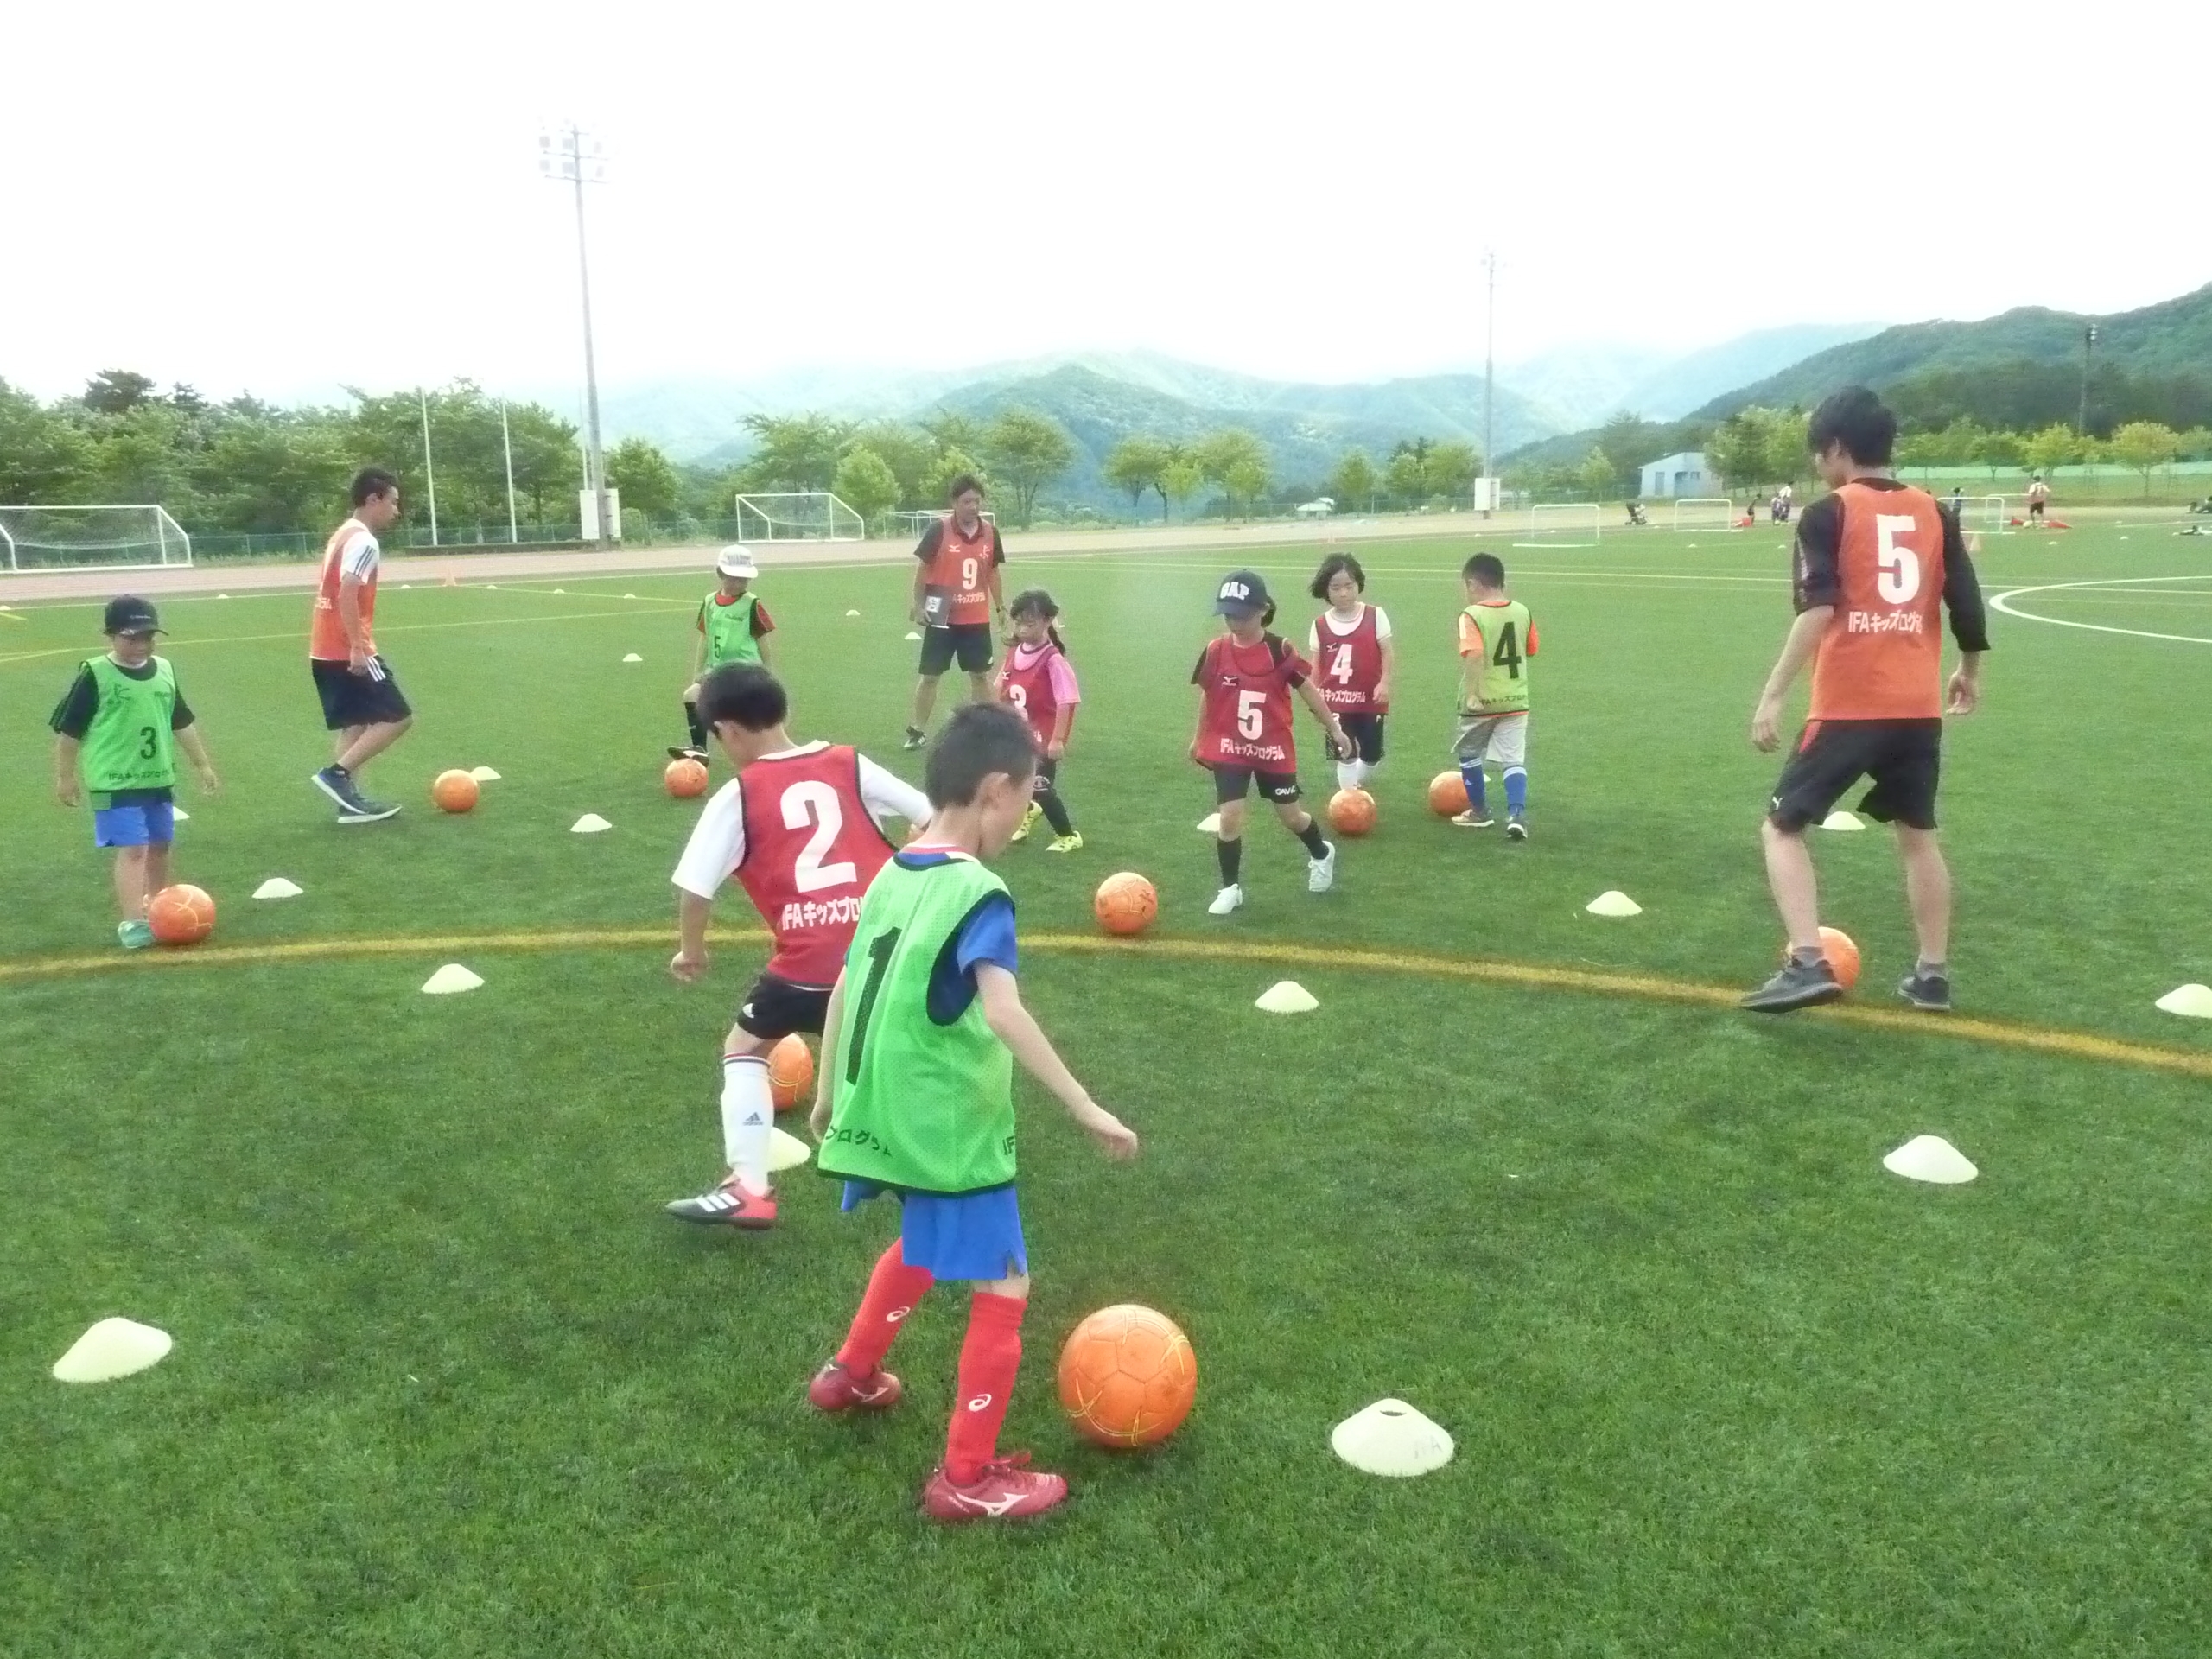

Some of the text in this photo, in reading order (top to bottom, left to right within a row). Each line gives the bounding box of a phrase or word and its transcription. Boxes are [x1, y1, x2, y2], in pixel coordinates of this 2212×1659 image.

[962, 557, 979, 590] 9
[1876, 513, 1920, 605] 5
[1220, 582, 1249, 601] GAP
[714, 635, 721, 659] 5
[1330, 643, 1354, 685] 4
[1492, 621, 1522, 679] 4
[1237, 690, 1267, 740] 5
[139, 726, 157, 760] 3
[780, 780, 857, 893] 2
[782, 896, 863, 931] IFAキッズプロ
[845, 926, 902, 1087] 1
